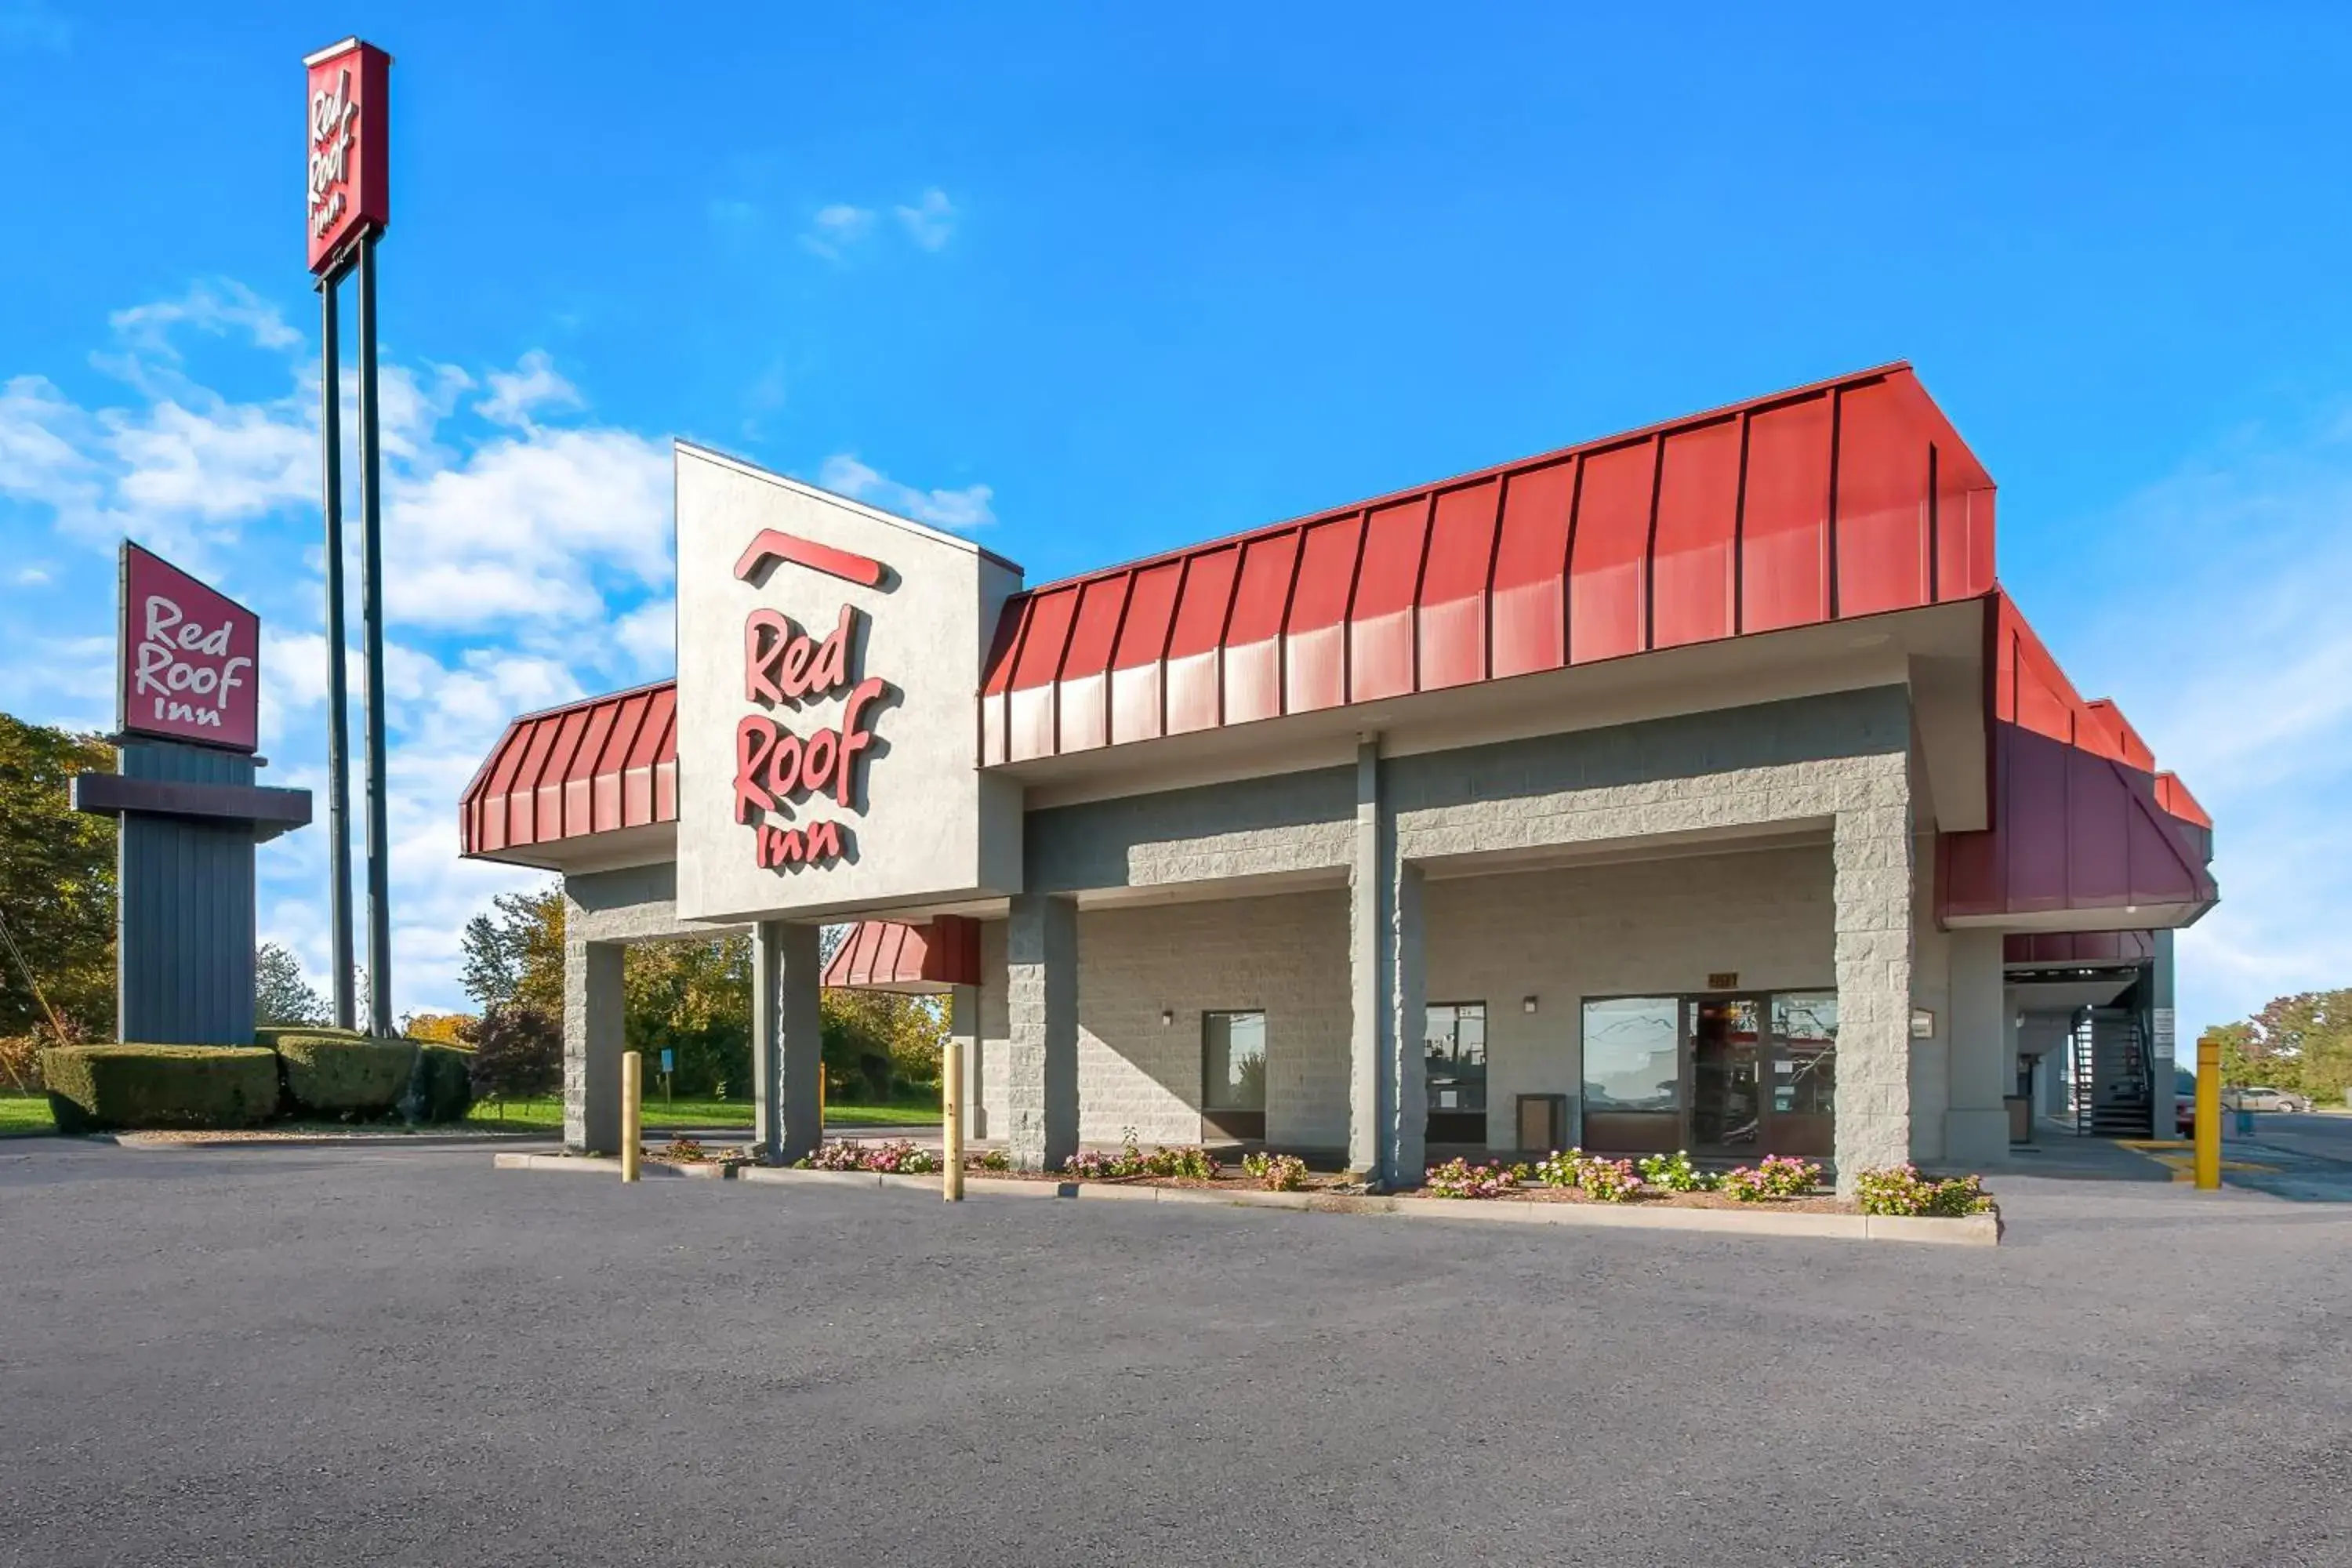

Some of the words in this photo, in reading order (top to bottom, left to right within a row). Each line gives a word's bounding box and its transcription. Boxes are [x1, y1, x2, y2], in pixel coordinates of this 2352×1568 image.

[311, 68, 348, 147] Red
[307, 100, 357, 220] Roof
[146, 595, 232, 656] Red
[746, 603, 852, 703] Red
[135, 642, 251, 709] Roof
[733, 677, 883, 825] Roof
